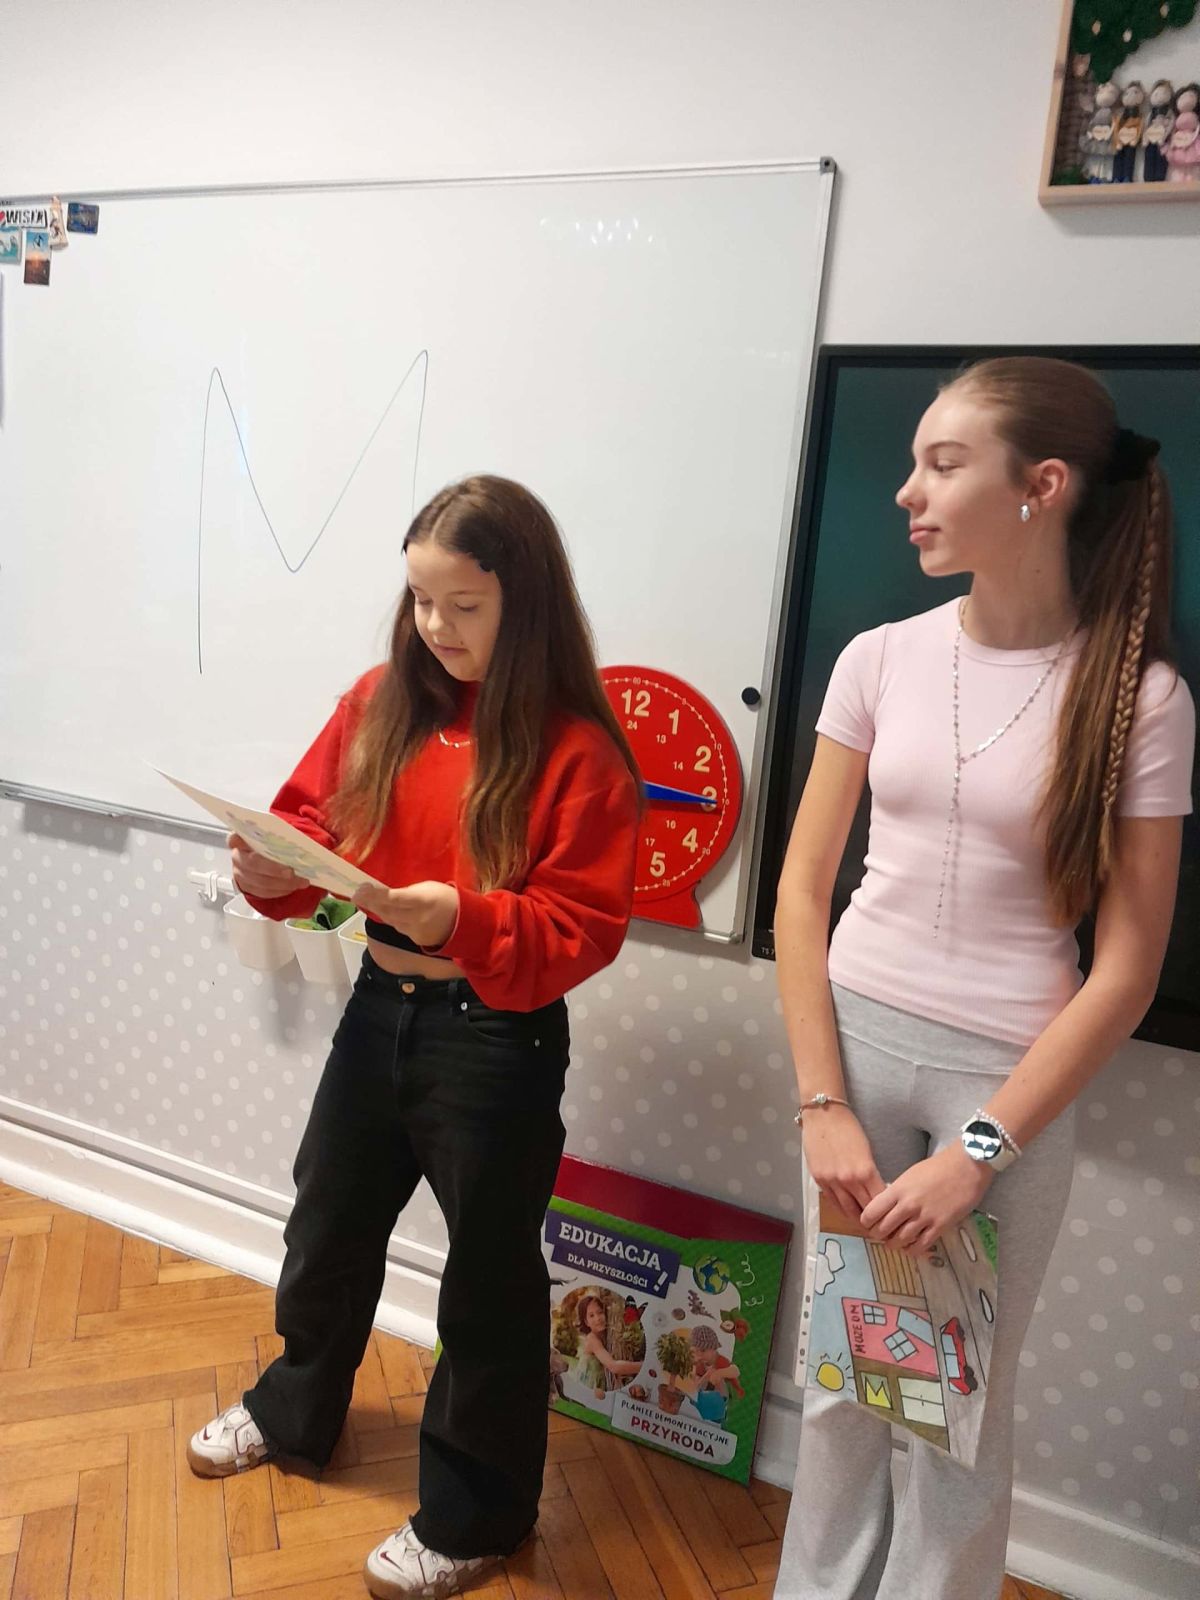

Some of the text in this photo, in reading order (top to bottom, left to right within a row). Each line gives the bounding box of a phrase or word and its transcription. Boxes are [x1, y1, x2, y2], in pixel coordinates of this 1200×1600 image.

[621, 688, 651, 717] 12
[627, 720, 638, 730] 24
[668, 709, 679, 735] 1
[673, 761, 684, 771] 14
[694, 745, 712, 773] 2
[645, 838, 655, 847] 17
[682, 827, 698, 853] 4
[649, 851, 666, 877] 5
[558, 1222, 661, 1271] EDUKACJA
[567, 1253, 585, 1267] DLA
[587, 1261, 648, 1288] PRZYSZŁOŚCI
[631, 1416, 714, 1457] PRZYRODA
